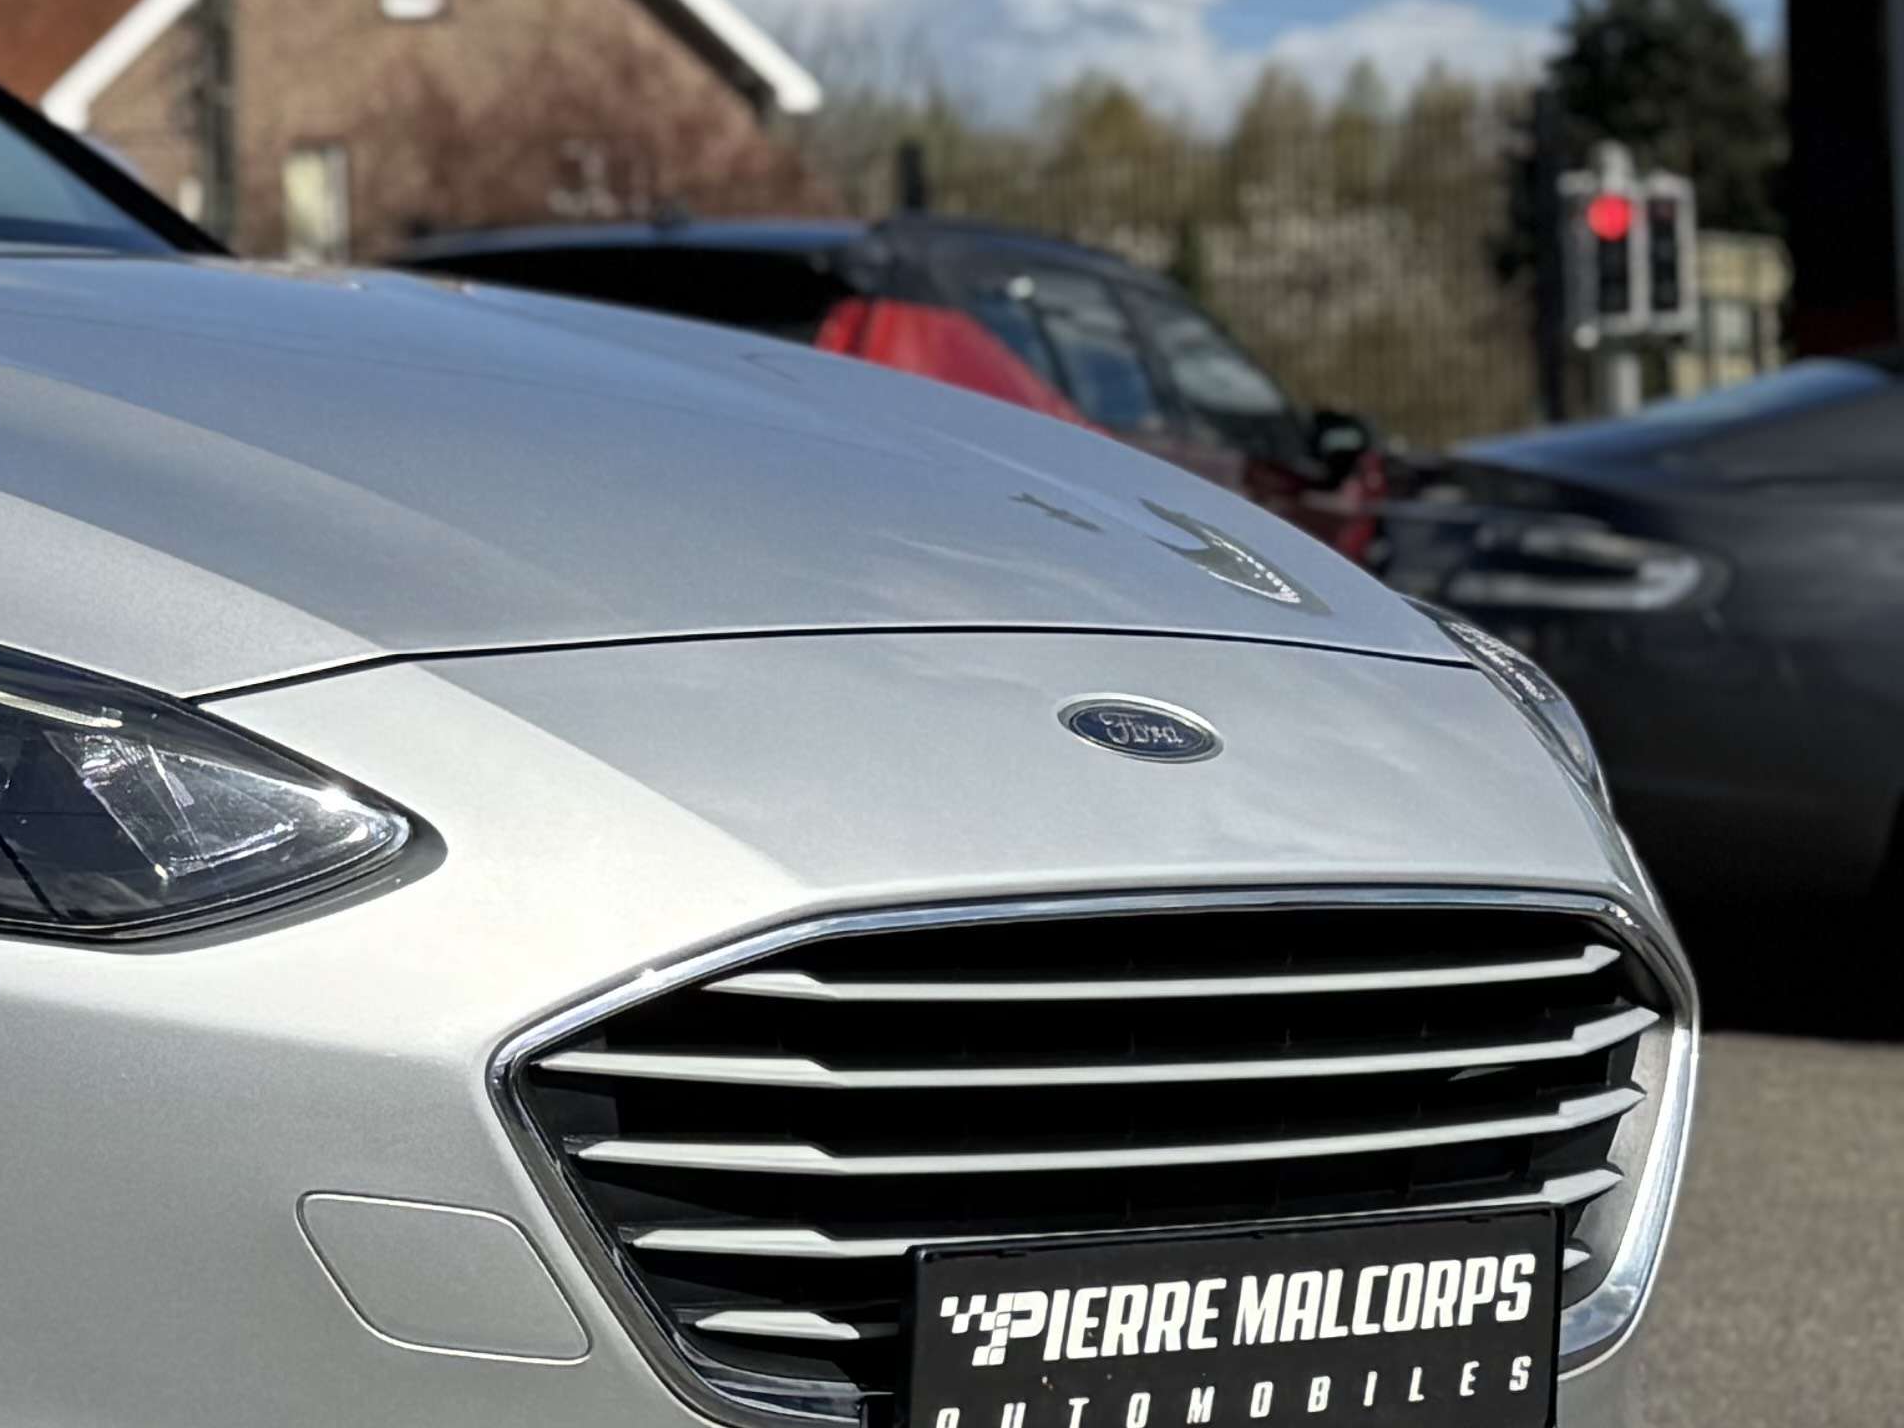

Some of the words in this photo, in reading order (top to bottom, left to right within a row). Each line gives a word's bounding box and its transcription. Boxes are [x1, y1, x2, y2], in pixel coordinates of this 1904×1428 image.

[1098, 712, 1184, 746] Ford
[968, 1277, 1227, 1368] PIERRE
[1233, 1253, 1536, 1346] MALCORPS
